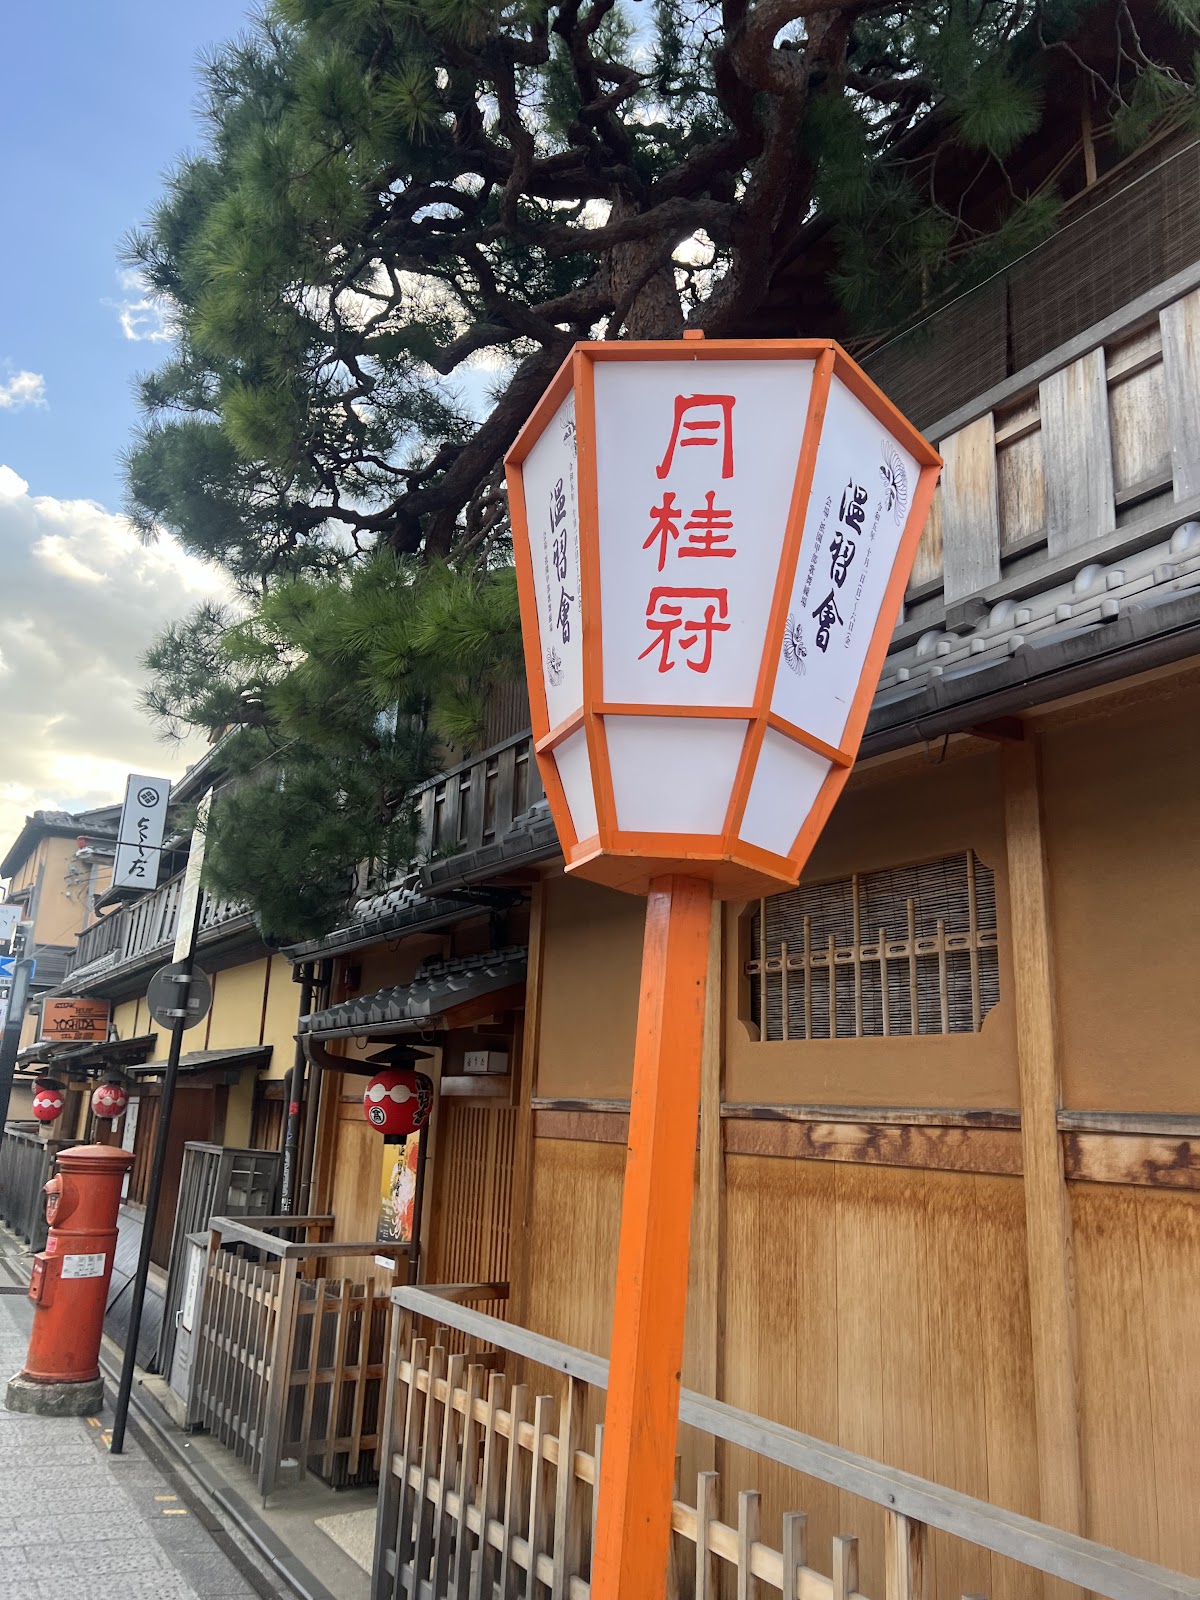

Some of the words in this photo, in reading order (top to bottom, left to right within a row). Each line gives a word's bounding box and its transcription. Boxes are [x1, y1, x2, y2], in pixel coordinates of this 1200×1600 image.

[637, 394, 737, 674] 月桂冠
[53, 1018, 95, 1030] YOSHIDA
